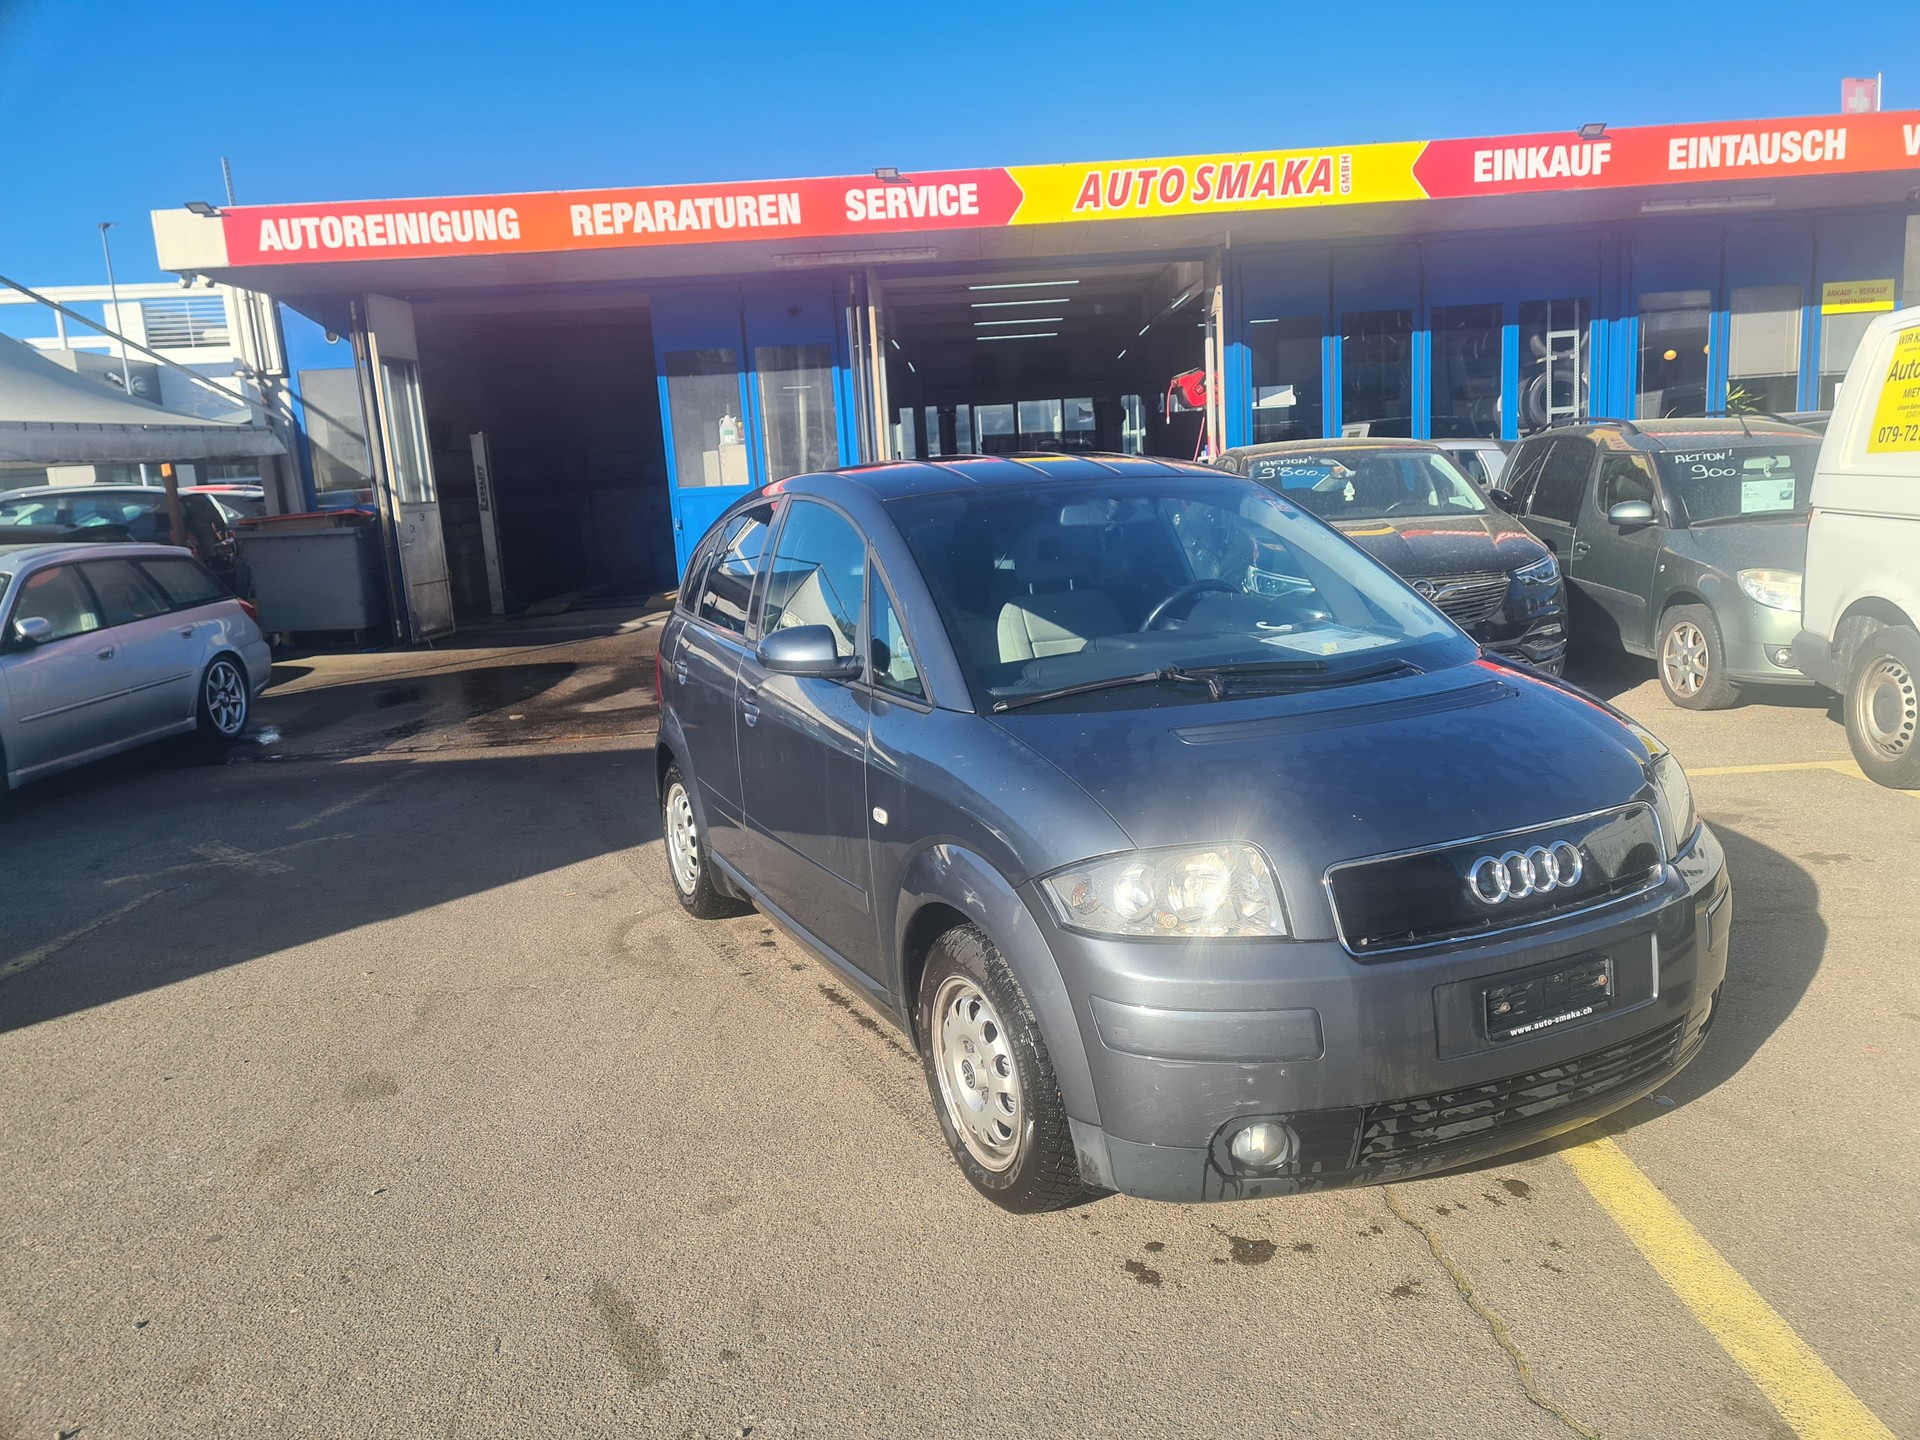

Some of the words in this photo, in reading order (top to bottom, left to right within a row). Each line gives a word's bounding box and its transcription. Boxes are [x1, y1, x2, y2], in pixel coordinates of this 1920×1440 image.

[1473, 142, 1612, 182] EINKAUF
[1668, 128, 1847, 170] EINTAUSCH
[1075, 167, 1185, 210] AUTO
[1192, 158, 1331, 202] SMAKA
[1341, 155, 1350, 193] GMBH
[570, 193, 802, 237] REPARATUREN
[844, 183, 979, 222] SERVICE
[259, 207, 521, 252] AUTOREINIGUNG
[1826, 288, 1852, 297] ANKAUF
[1878, 424, 1920, 444] 079-72
[1509, 1006, 1593, 1037] www.auto-smaka.ch
